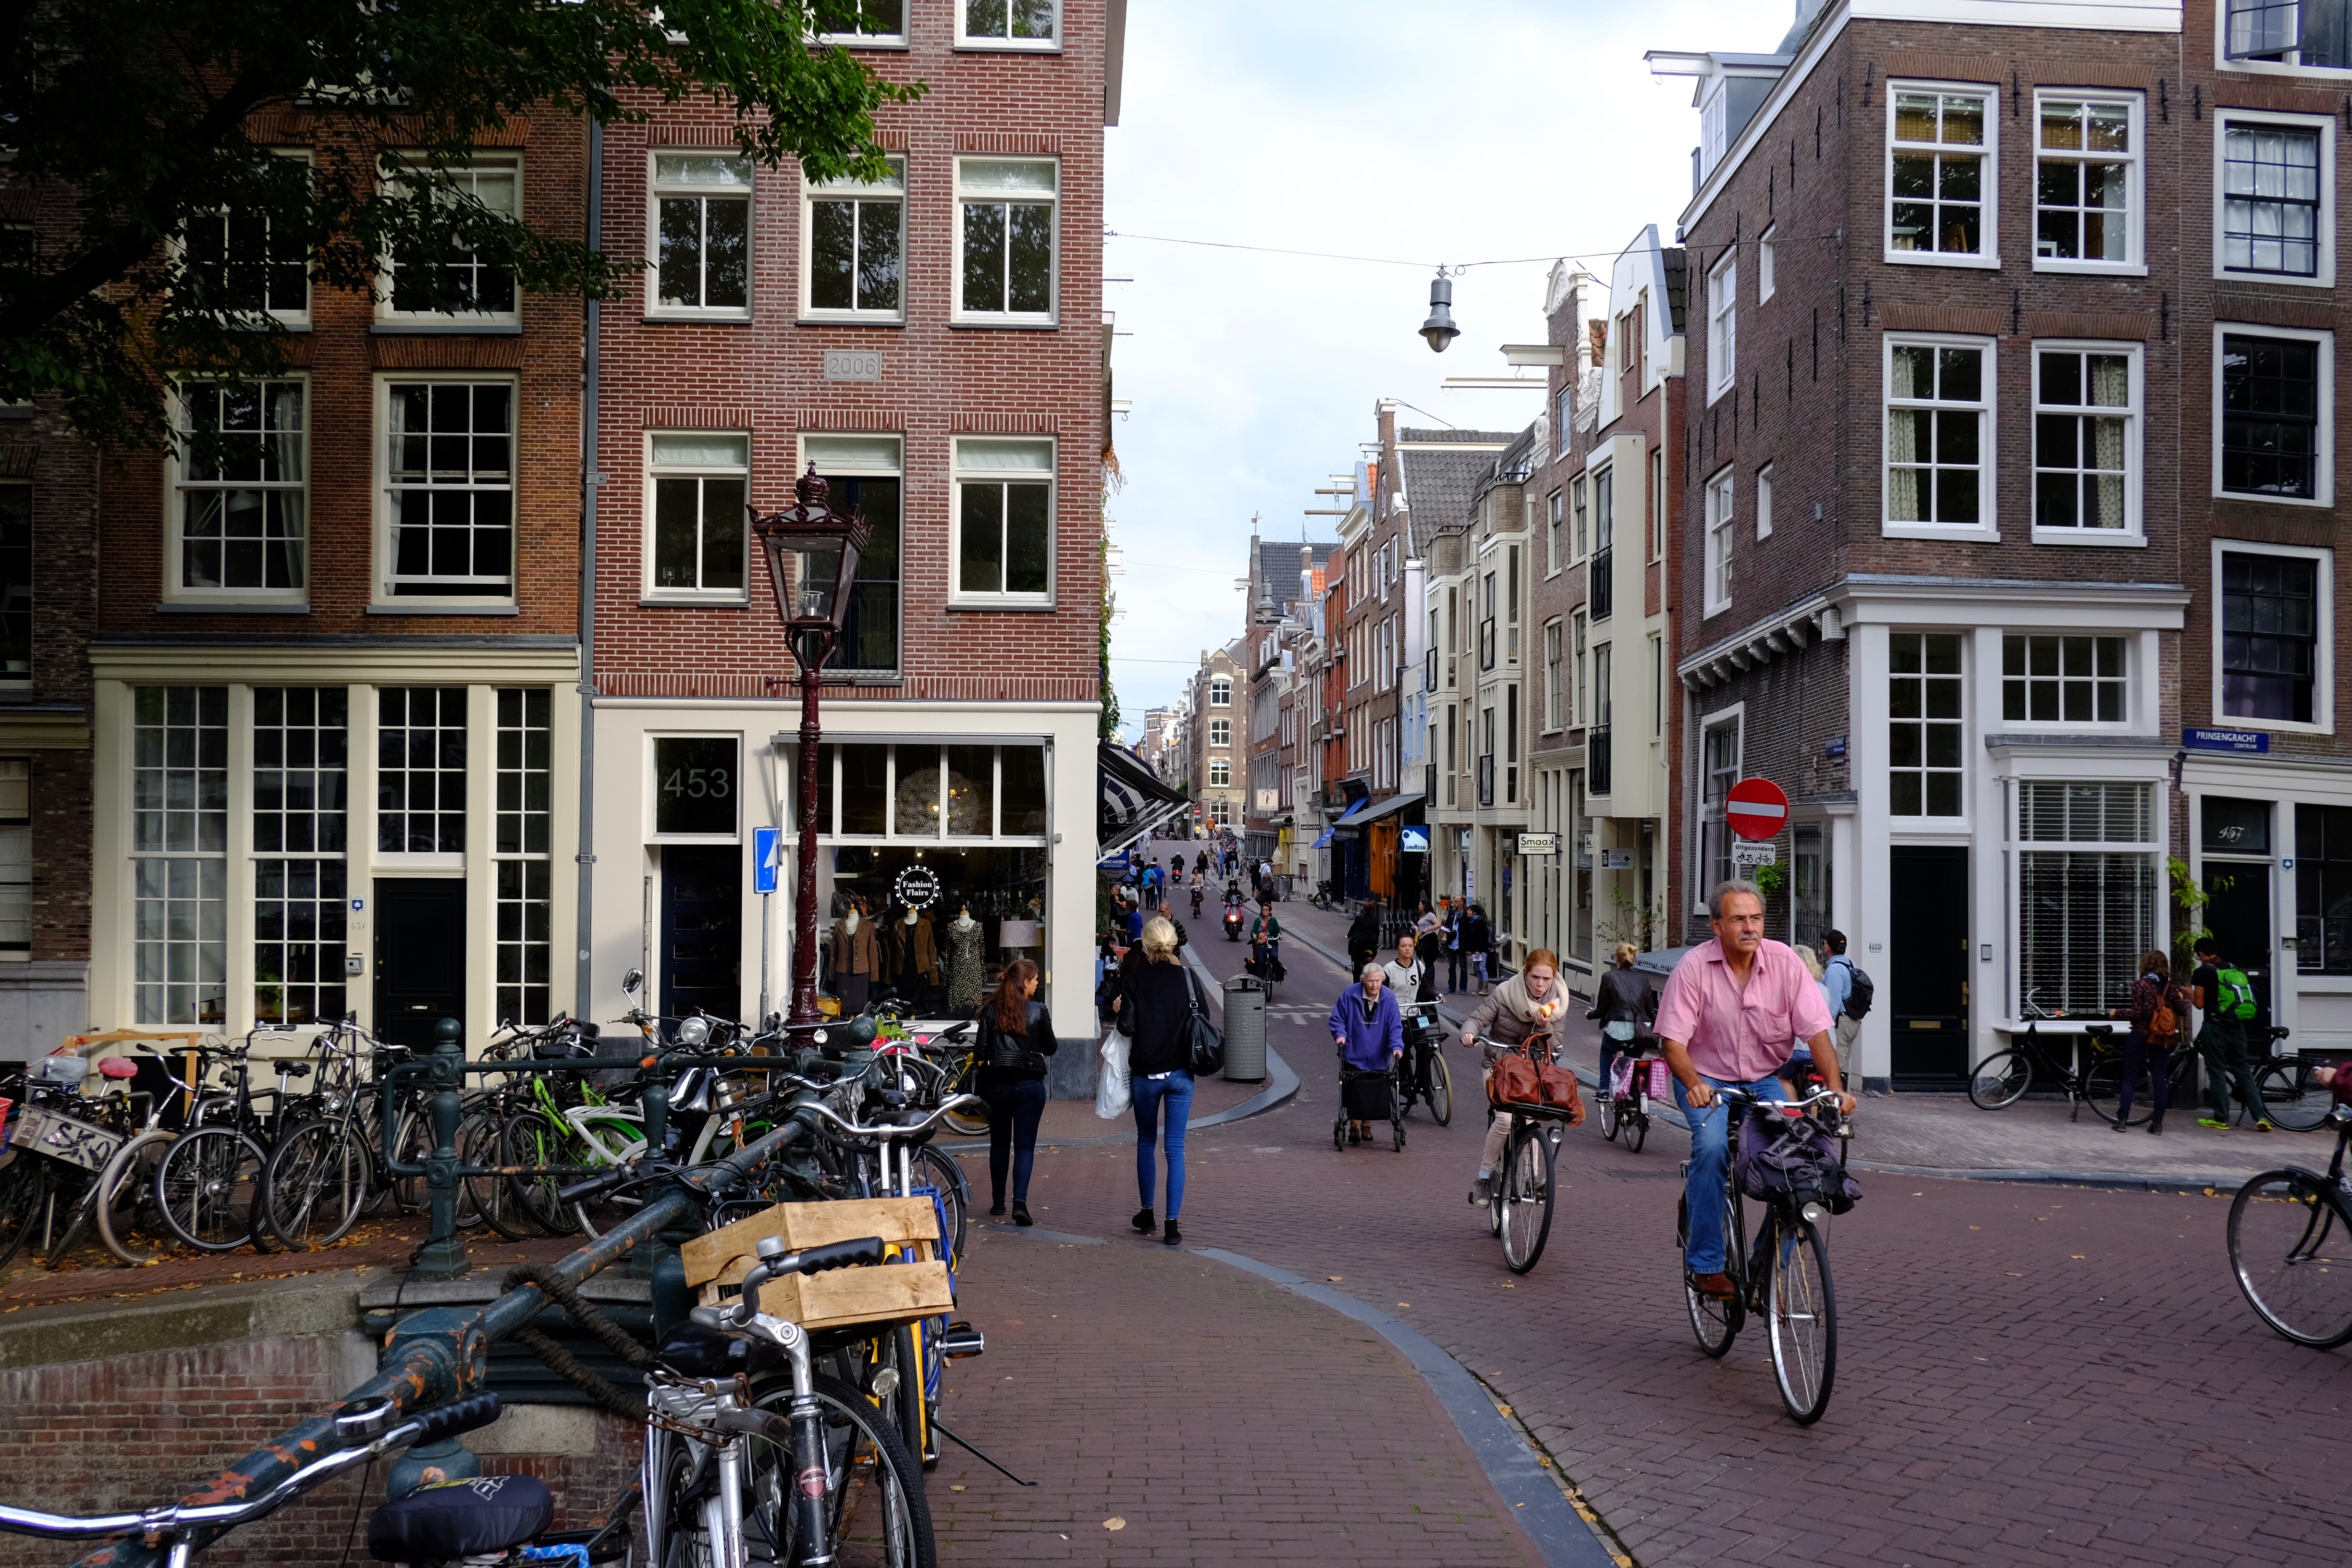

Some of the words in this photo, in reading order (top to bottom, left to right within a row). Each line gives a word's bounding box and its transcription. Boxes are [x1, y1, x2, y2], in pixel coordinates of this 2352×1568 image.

[829, 356, 877, 374] 2006
[2196, 731, 2257, 743] PRINSENGRACHT
[663, 768, 729, 797] 453
[1520, 836, 1554, 846] Smaak
[2218, 826, 2245, 843] 457
[1410, 974, 1418, 986] S
